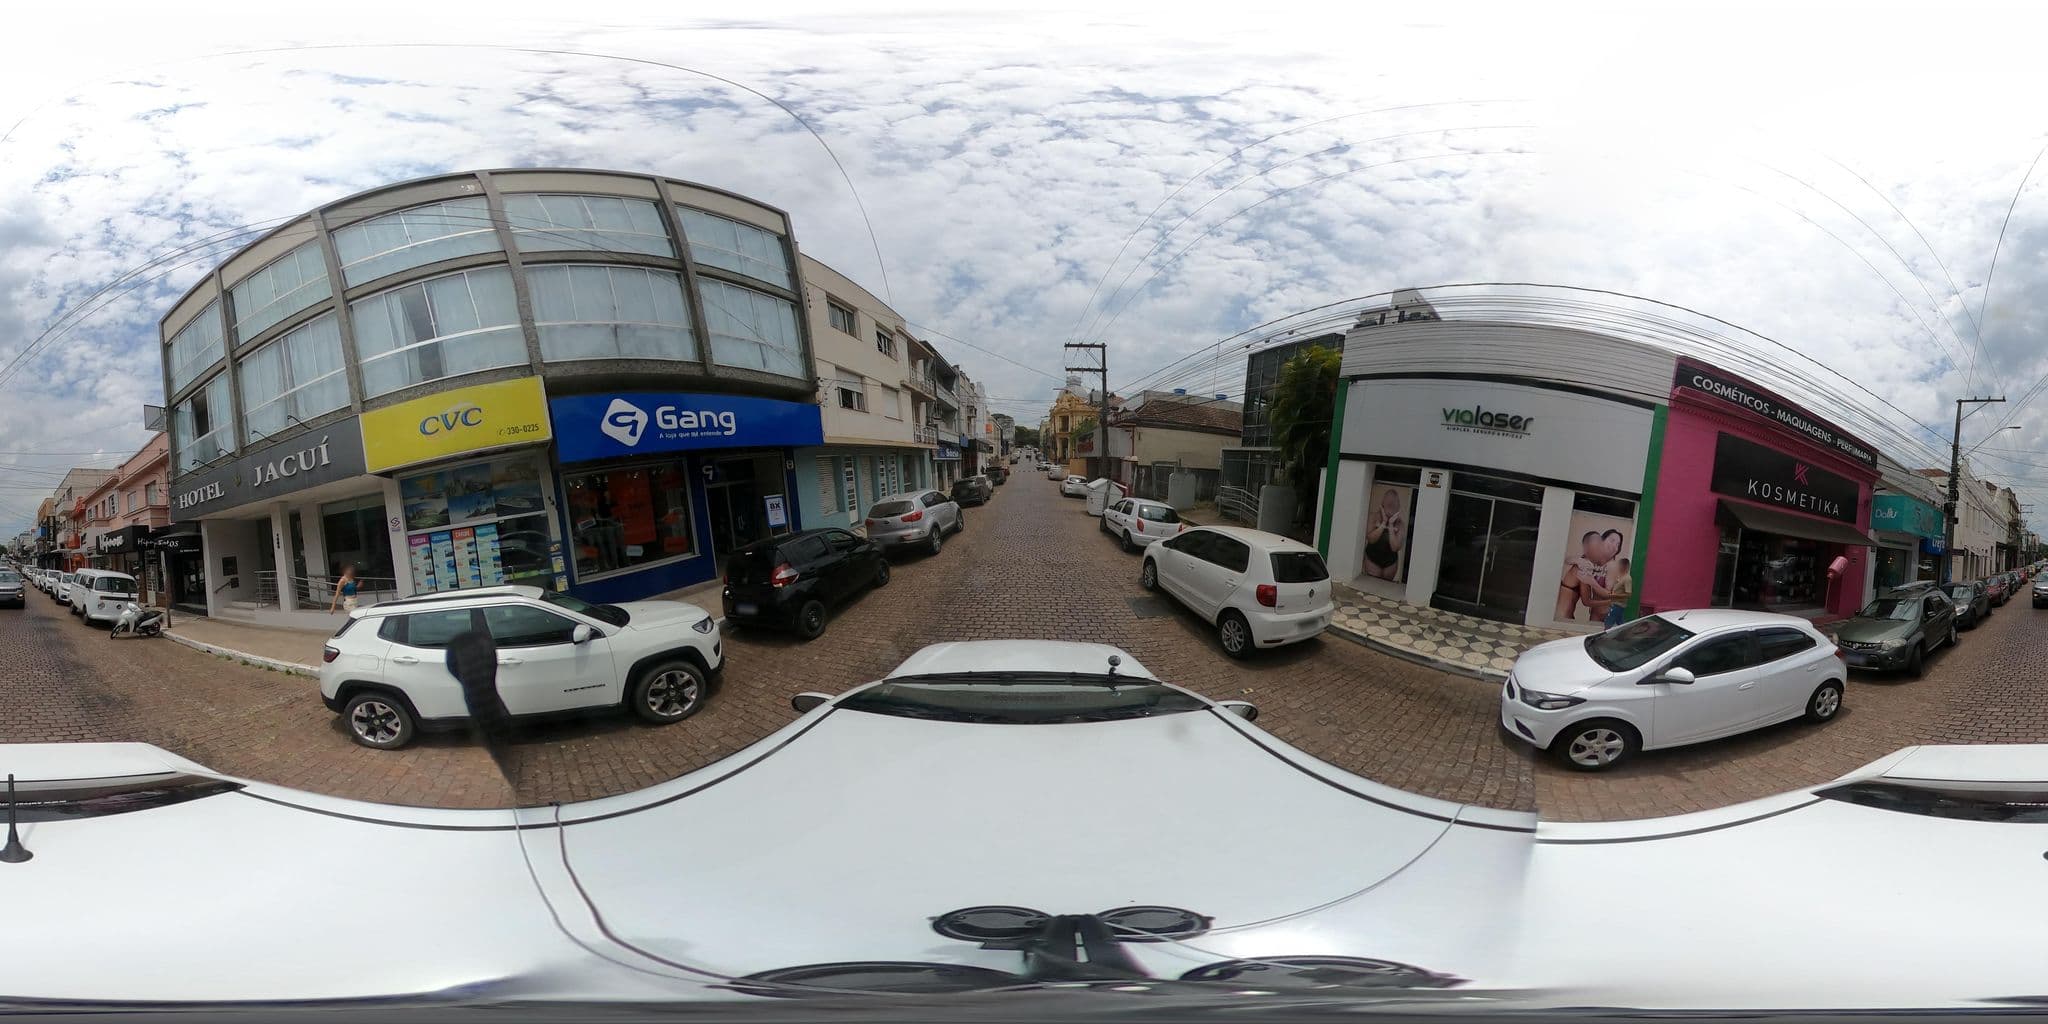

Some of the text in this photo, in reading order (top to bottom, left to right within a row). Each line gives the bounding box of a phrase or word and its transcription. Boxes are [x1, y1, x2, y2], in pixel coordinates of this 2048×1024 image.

[419, 407, 483, 436] CVC
[655, 405, 737, 436] Gang
[1442, 405, 1534, 431] vialaser
[1692, 375, 1770, 414] COSMÉTICOS
[1776, 408, 1833, 443] MAQUIAGENS
[254, 435, 330, 487] JACUÍ
[179, 481, 225, 509] HOTEL
[1747, 479, 1840, 516] KOSMETIKA
